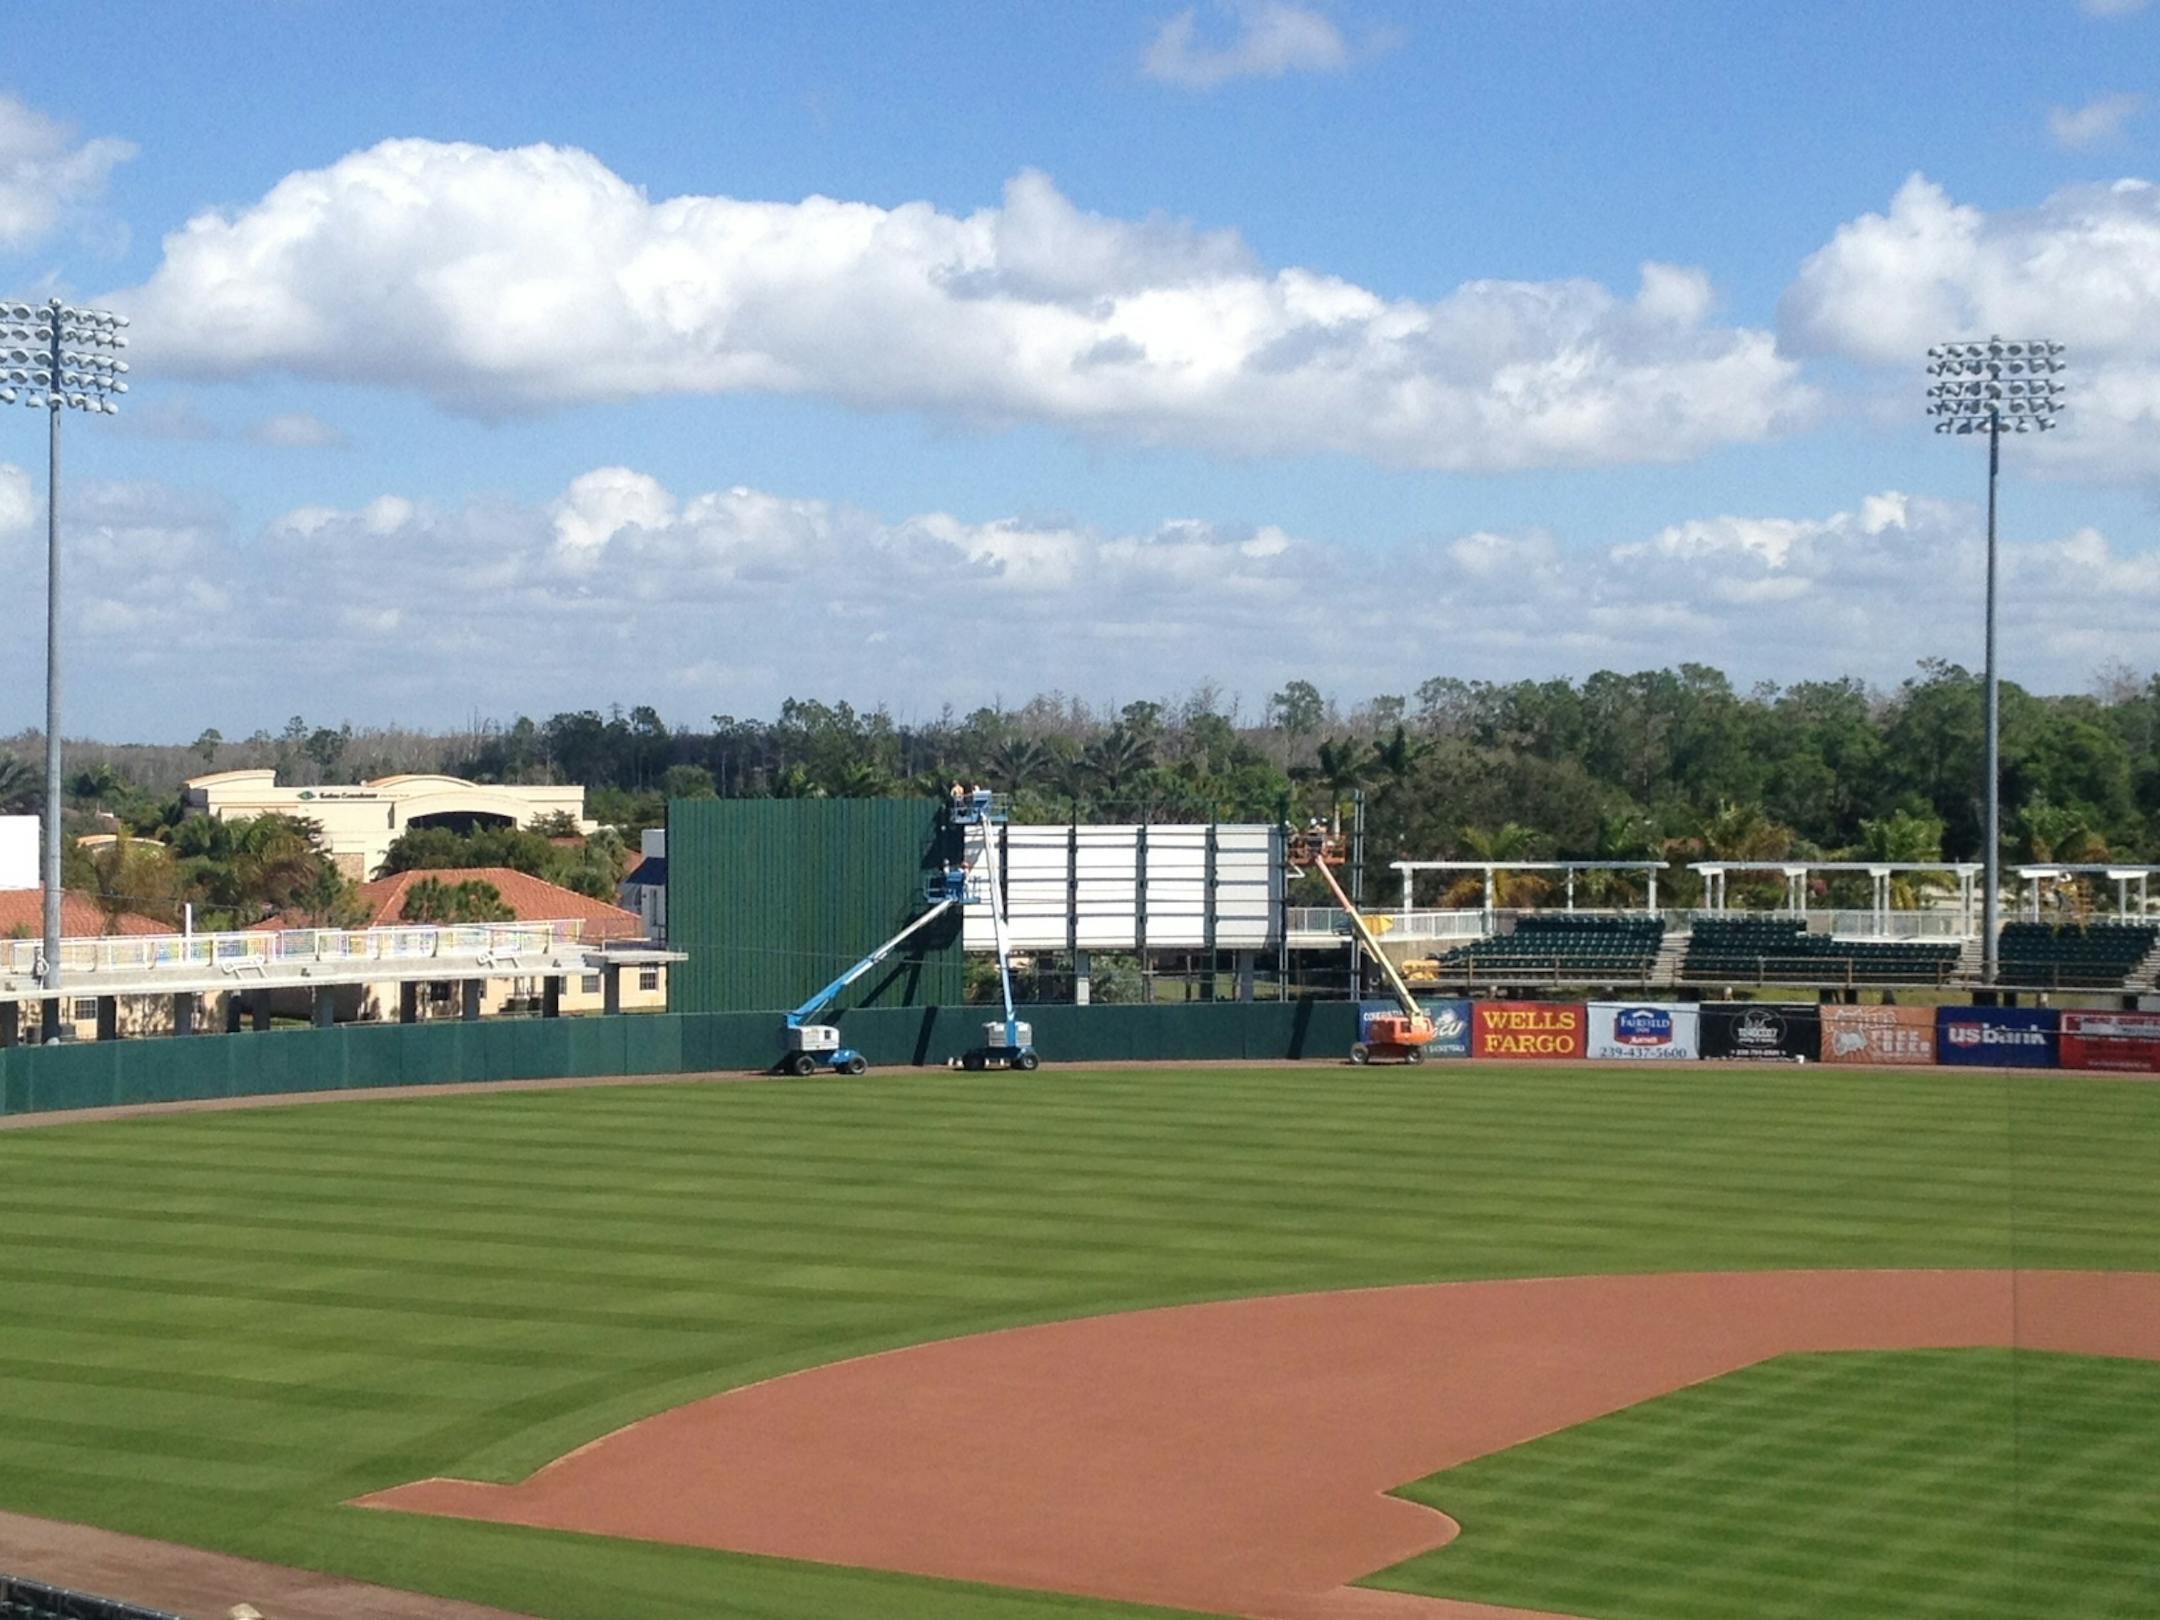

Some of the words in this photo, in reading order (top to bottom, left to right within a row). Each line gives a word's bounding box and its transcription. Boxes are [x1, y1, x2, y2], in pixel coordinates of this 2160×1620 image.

[1482, 1011, 1576, 1030] WELLS
[1620, 1015, 1670, 1028] FAIRFIELD
[1484, 1034, 1574, 1054] FARGO
[1600, 1046, 1687, 1059] 239-437-5600
